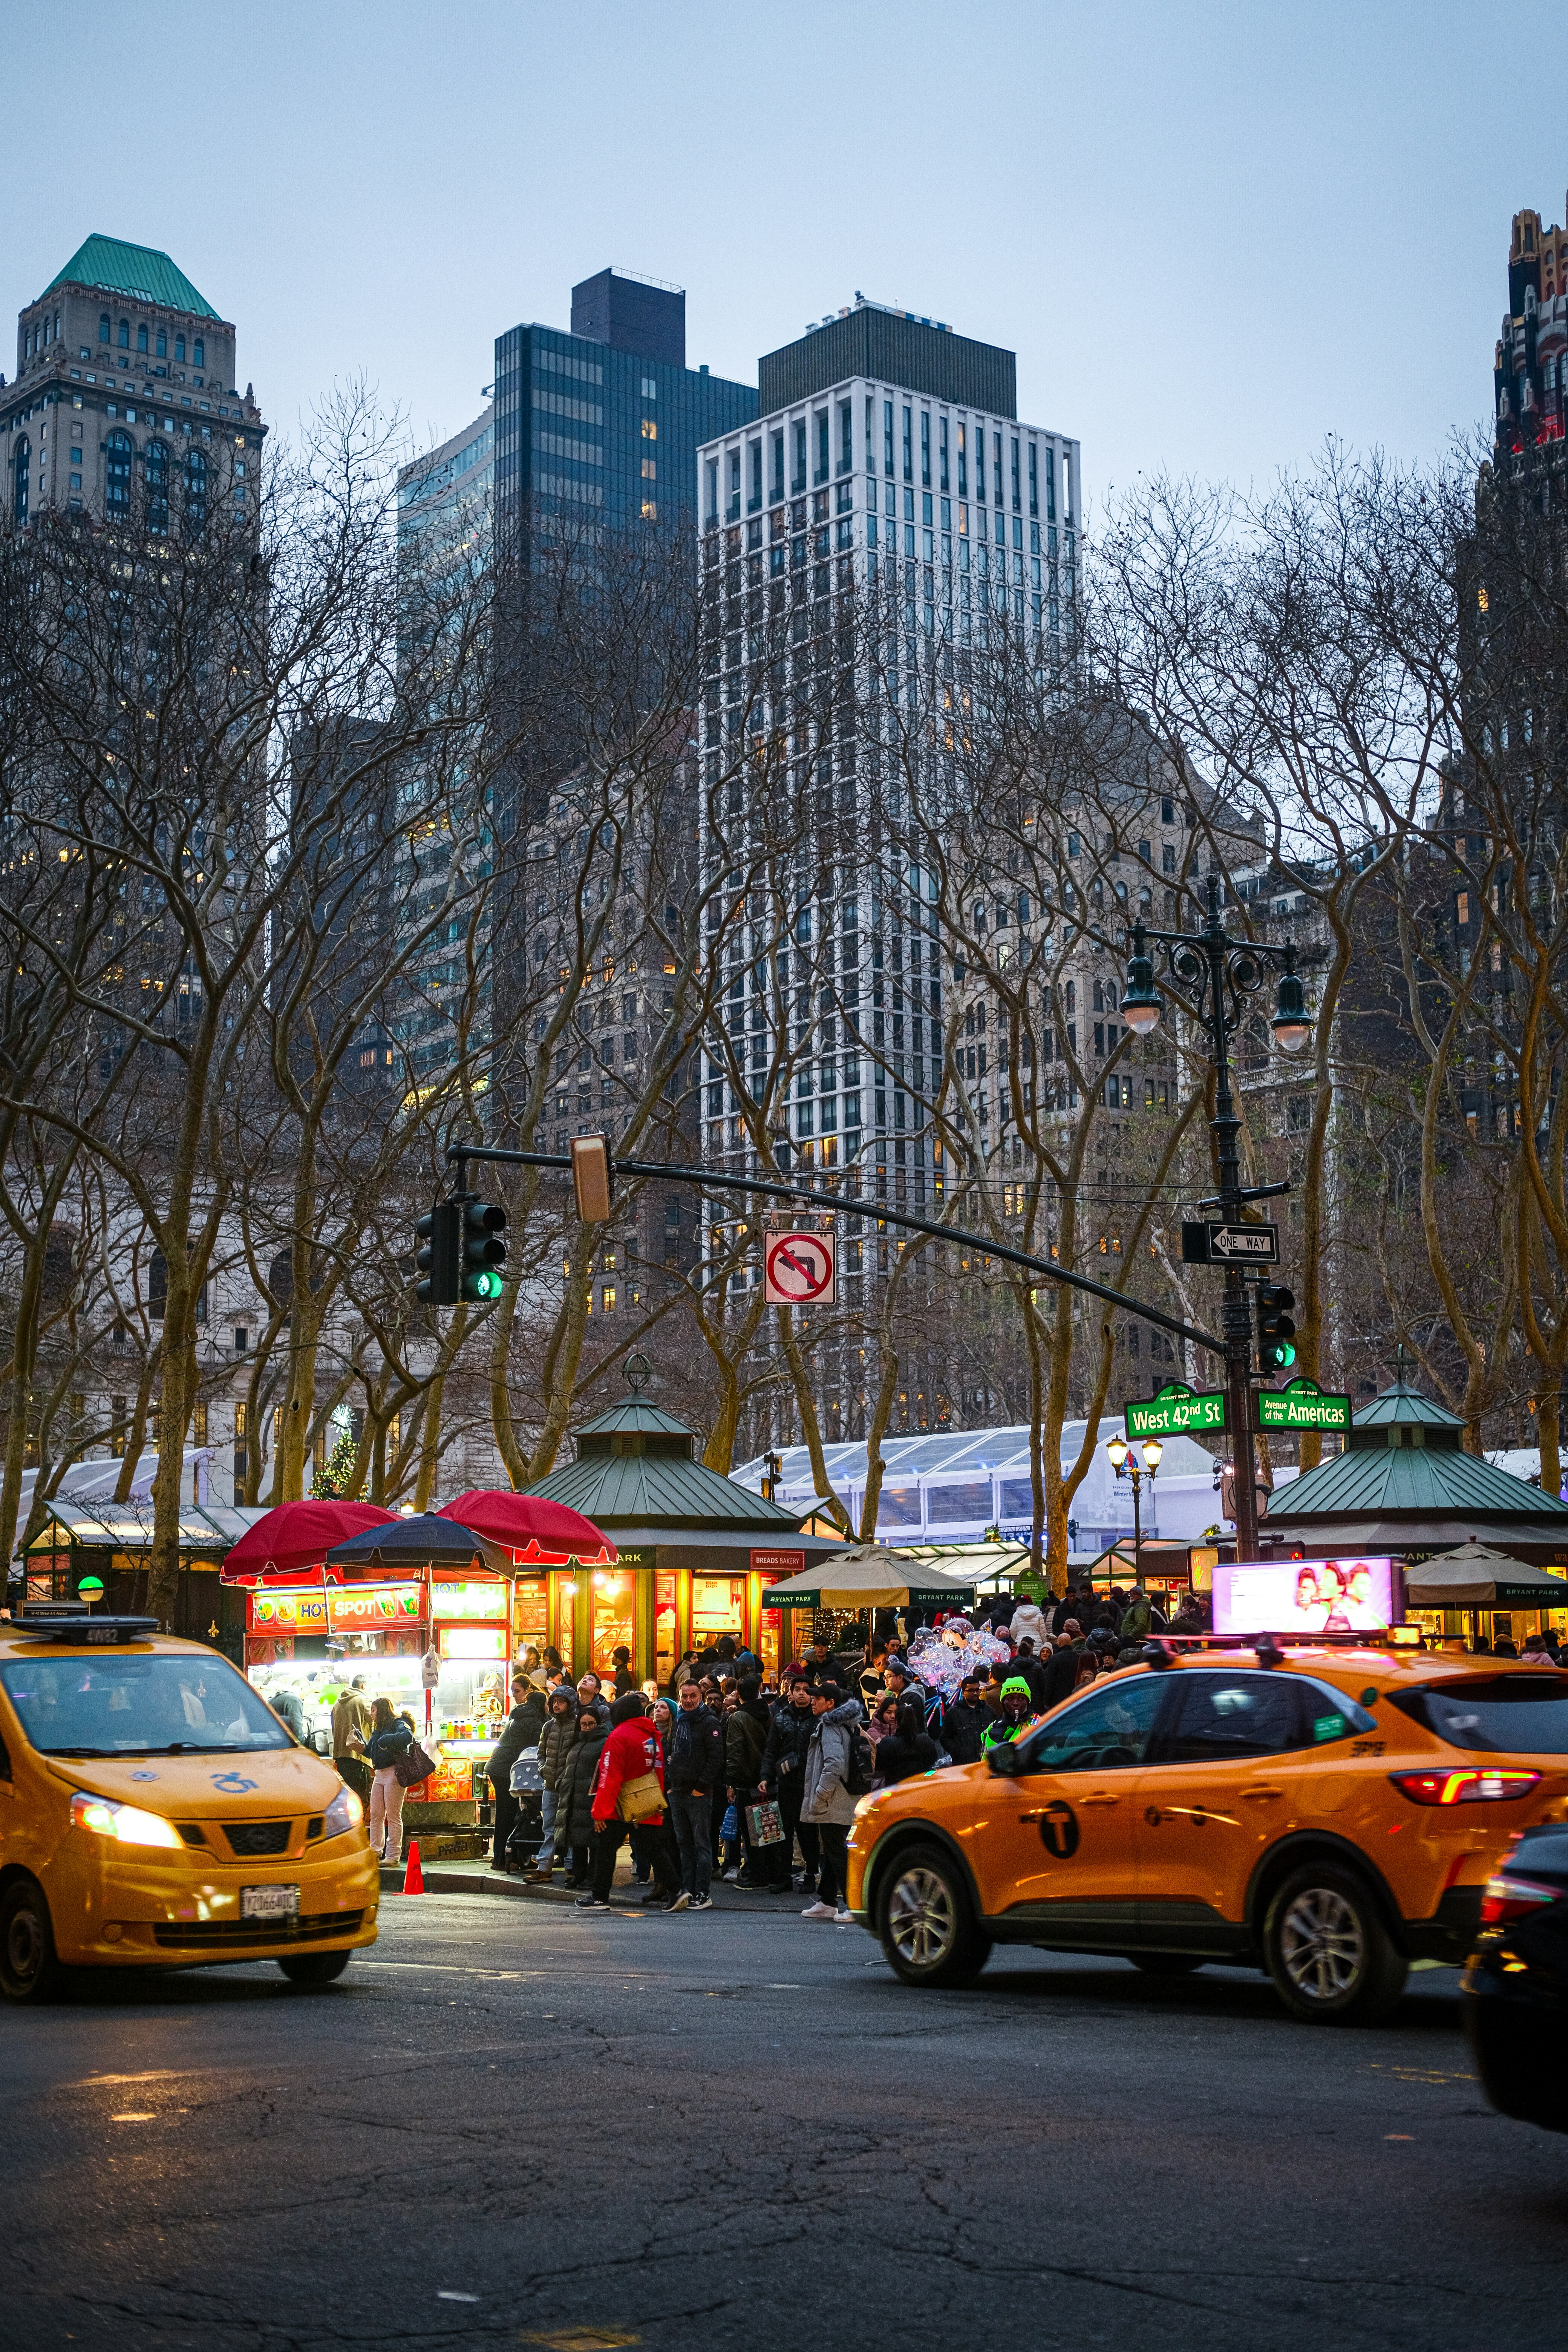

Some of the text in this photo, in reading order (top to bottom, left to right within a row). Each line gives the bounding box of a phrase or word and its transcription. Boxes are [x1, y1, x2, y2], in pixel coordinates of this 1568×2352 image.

[1220, 1235, 1265, 1250] ONE WAY
[1265, 1400, 1287, 1410] Avenue
[1288, 1402, 1345, 1423] Americas
[1133, 1402, 1220, 1430] West 42nd St
[1265, 1410, 1283, 1420] of the
[301, 1600, 375, 1618] HOT SPOT
